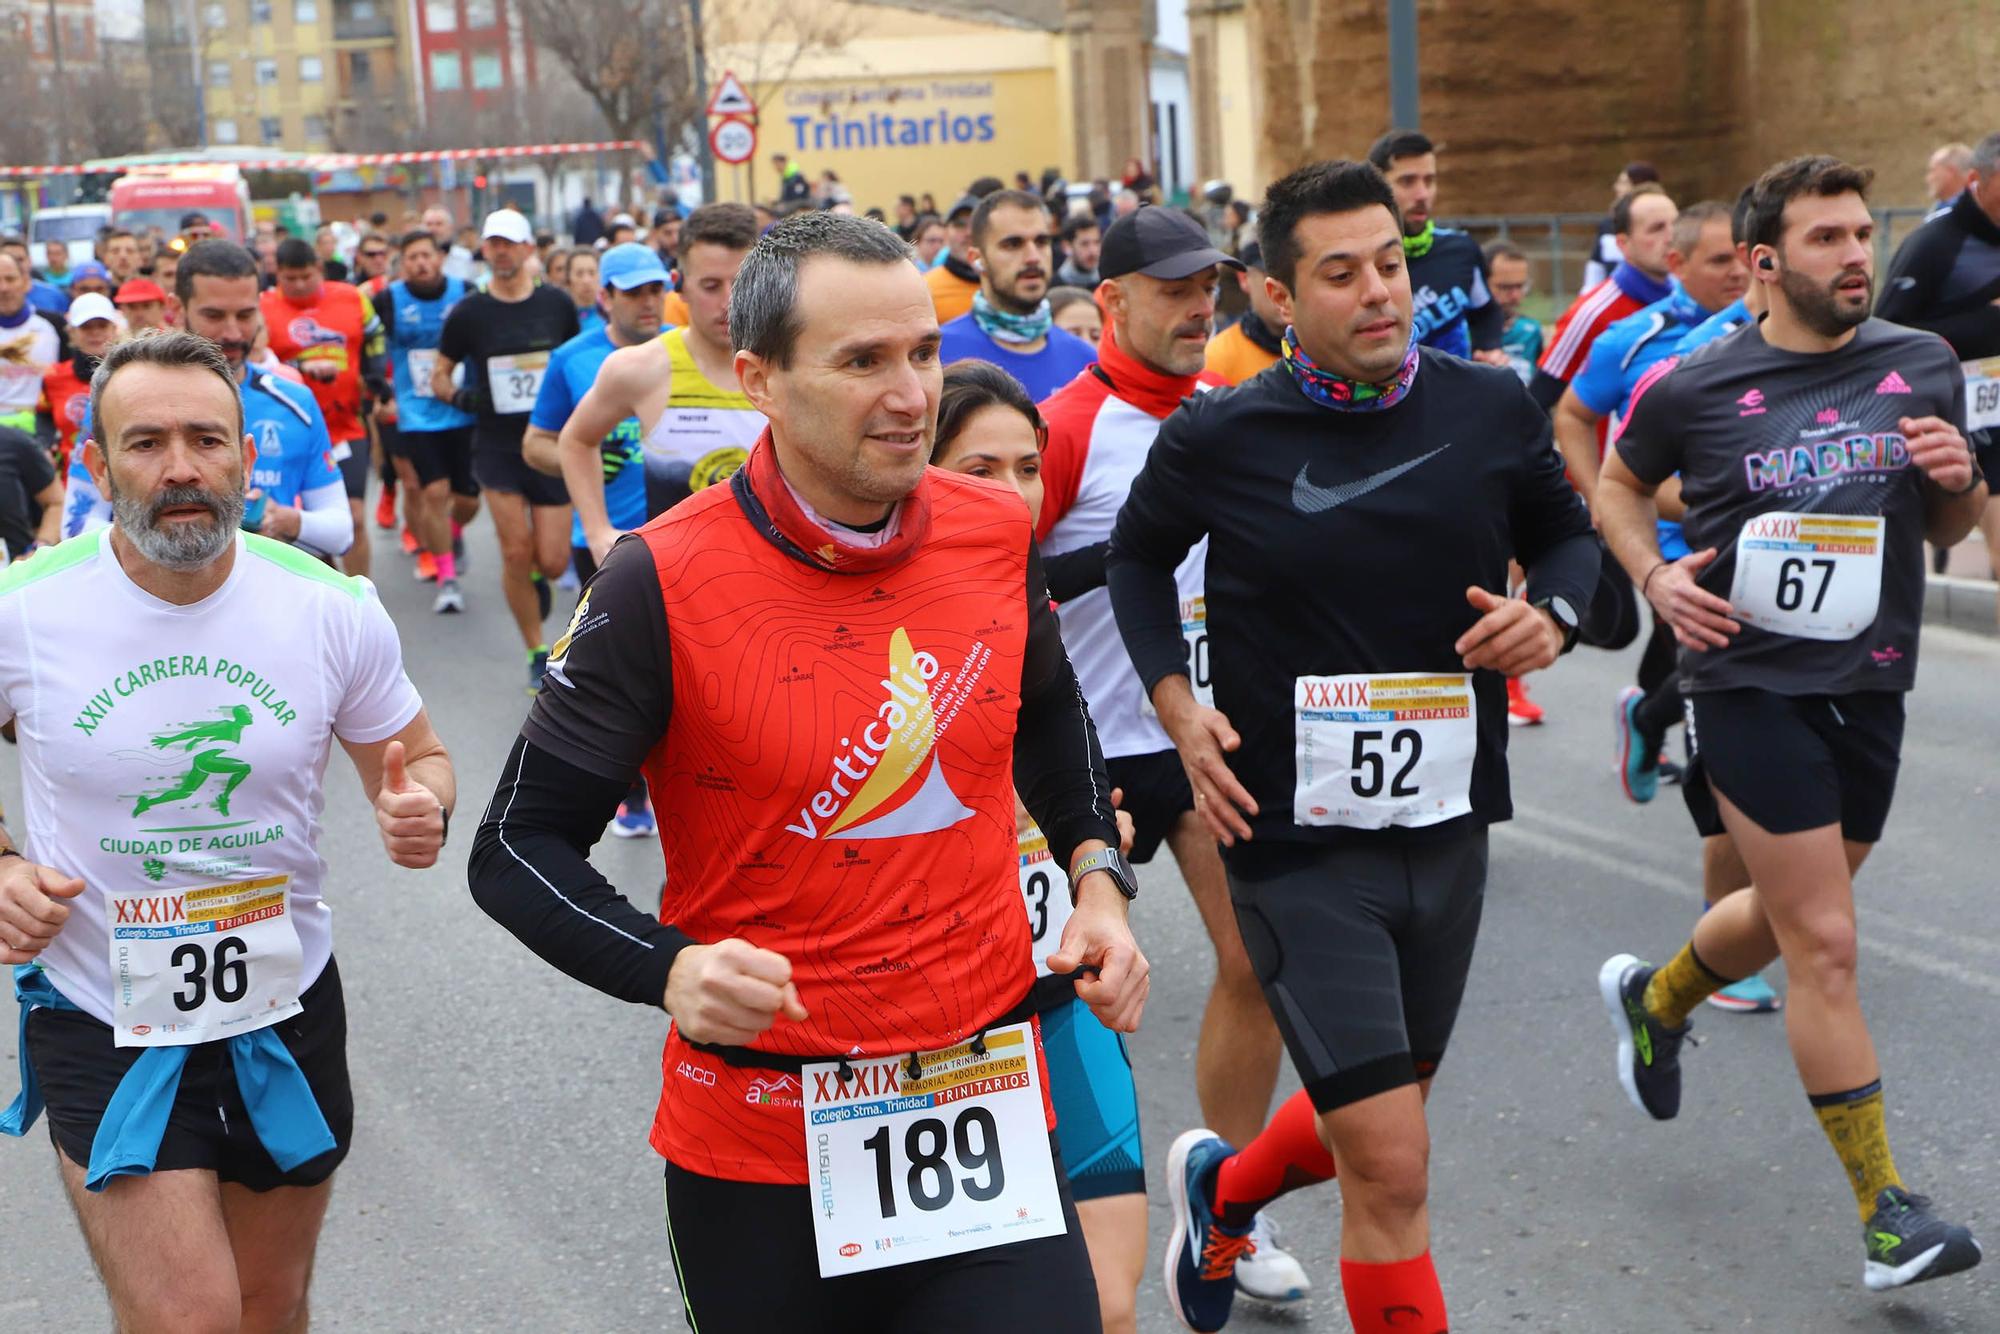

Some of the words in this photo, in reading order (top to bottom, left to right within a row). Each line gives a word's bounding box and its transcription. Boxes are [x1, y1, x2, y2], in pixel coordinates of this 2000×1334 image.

[788, 108, 995, 150] Trinitarios
[509, 374, 537, 399] 32
[1976, 382, 2000, 413] 69
[1744, 432, 1911, 492] MADRID
[1748, 518, 1798, 538] XXXIX
[1775, 557, 1837, 614] 67
[73, 688, 114, 737] XXIV
[114, 655, 208, 697] CARRERA
[213, 659, 297, 727] POPULAR
[899, 719, 920, 744] club
[915, 669, 951, 721] deportivo
[903, 647, 993, 775] www.clubverticalia.com
[908, 737, 922, 753] de
[919, 692, 953, 738] montaña
[946, 683, 958, 695] y
[954, 640, 984, 684] escalada
[1303, 682, 1368, 707] XXXIX
[1398, 708, 1469, 720] TRINITARIOS
[784, 651, 939, 840] verticalia
[1351, 728, 1423, 798] 52
[100, 838, 173, 855] CIUDAD
[179, 837, 202, 853] DE
[207, 825, 285, 849] AGUILAR
[187, 888, 222, 900] CARRERA
[223, 881, 254, 894] POPULAR
[231, 889, 261, 903] TRINIDAD
[1027, 871, 1050, 943] 3
[114, 895, 185, 924] XXXIX
[115, 928, 147, 939] Colegio
[147, 927, 172, 938] Stma.
[175, 922, 210, 936] Trinidad
[219, 904, 284, 930] TRINITARIOS
[188, 907, 228, 919] MEMORIAL
[171, 936, 248, 1012] 36
[902, 1050, 942, 1069] CRERA
[943, 1042, 984, 1059] POPUL
[902, 1063, 949, 1080] STÍSIMA
[950, 1051, 992, 1070] TRINIDAD
[676, 1060, 716, 1087] ARCO
[813, 1063, 900, 1104] XXXIX
[902, 1075, 947, 1092] MEMORIAL
[949, 1065, 987, 1080] "ADOLFO
[988, 1057, 1027, 1072] RIVERA"
[812, 1105, 851, 1124] Colegio
[852, 1102, 884, 1117] Stma.
[885, 1094, 928, 1112] Trinidad
[937, 1072, 1030, 1104] TRINITARIOS
[863, 1106, 1006, 1219] 189
